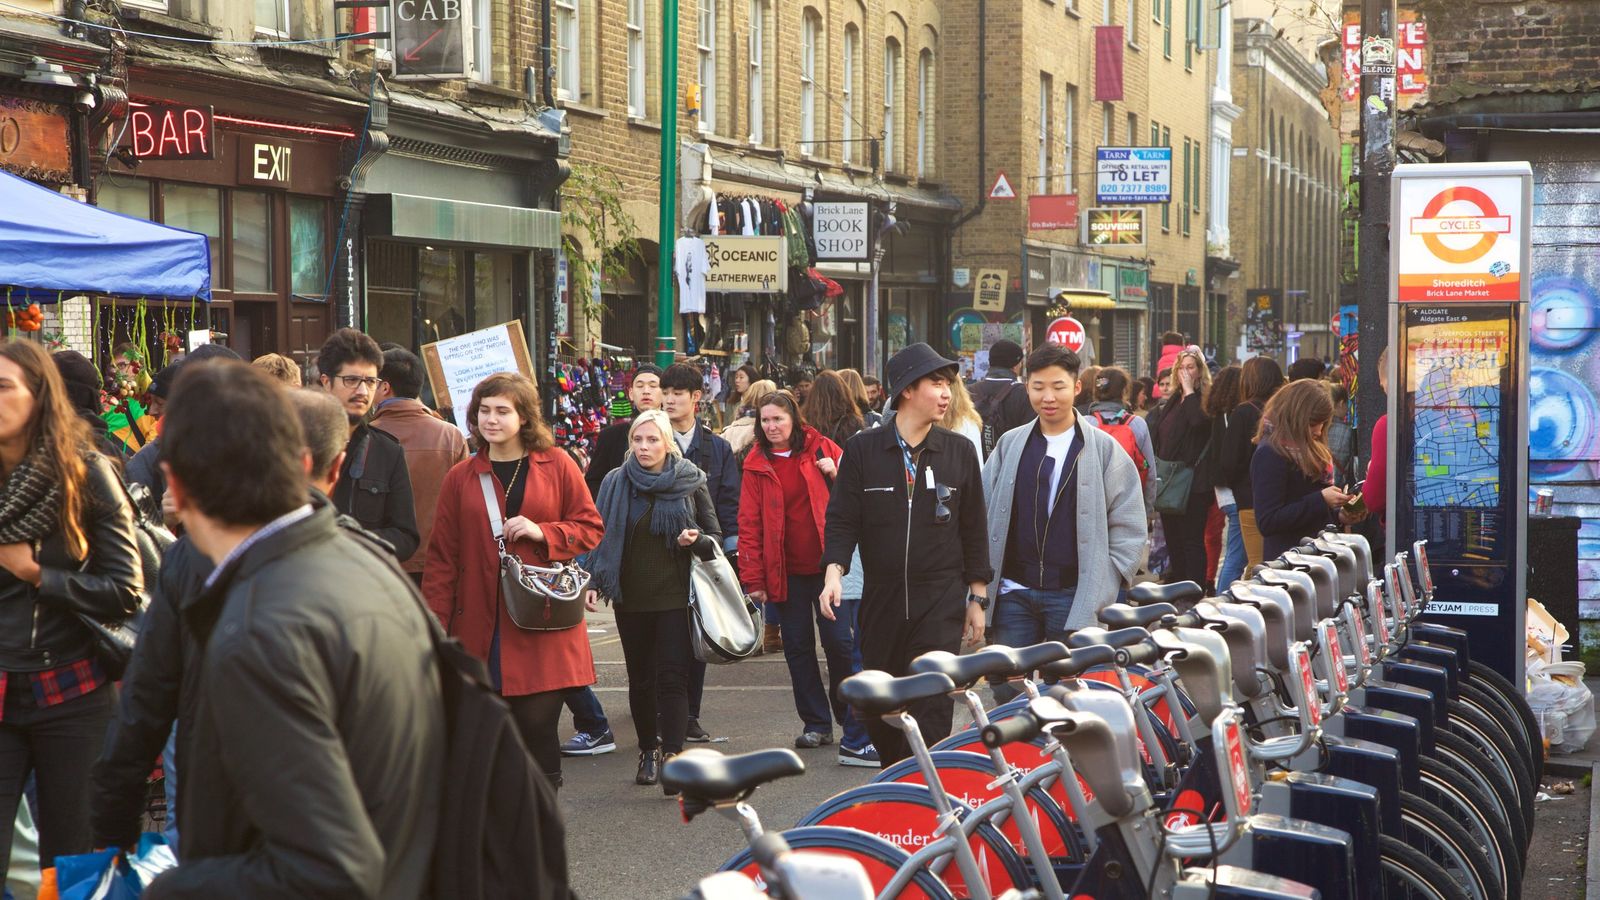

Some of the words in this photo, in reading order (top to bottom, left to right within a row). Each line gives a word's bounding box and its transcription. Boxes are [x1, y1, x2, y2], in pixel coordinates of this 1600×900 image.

[398, 0, 461, 21] CAB
[132, 109, 207, 156] BAR
[253, 143, 291, 182] EXIT
[1110, 171, 1128, 181] TO
[1133, 171, 1159, 181] LET
[1101, 184, 1117, 192] 020
[1121, 184, 1142, 192] 7377
[1145, 184, 1167, 192] 8989
[817, 206, 840, 215] Brick
[842, 206, 864, 215] Lane
[817, 219, 863, 232] BOOK
[1091, 222, 1140, 230] SOUVENIR
[1440, 220, 1481, 230] CYCLES
[1093, 231, 1109, 244] UK
[818, 239, 864, 252] SHOP
[721, 251, 777, 261] OCEANIC
[704, 273, 777, 283] LEATHERWEAR
[1432, 279, 1486, 288] Shoreditch
[1464, 289, 1490, 297] Market
[1048, 331, 1083, 343] ATM
[449, 345, 459, 353] THE
[487, 335, 500, 343] WAS
[486, 340, 506, 350] THRONE
[876, 828, 930, 847] tander
